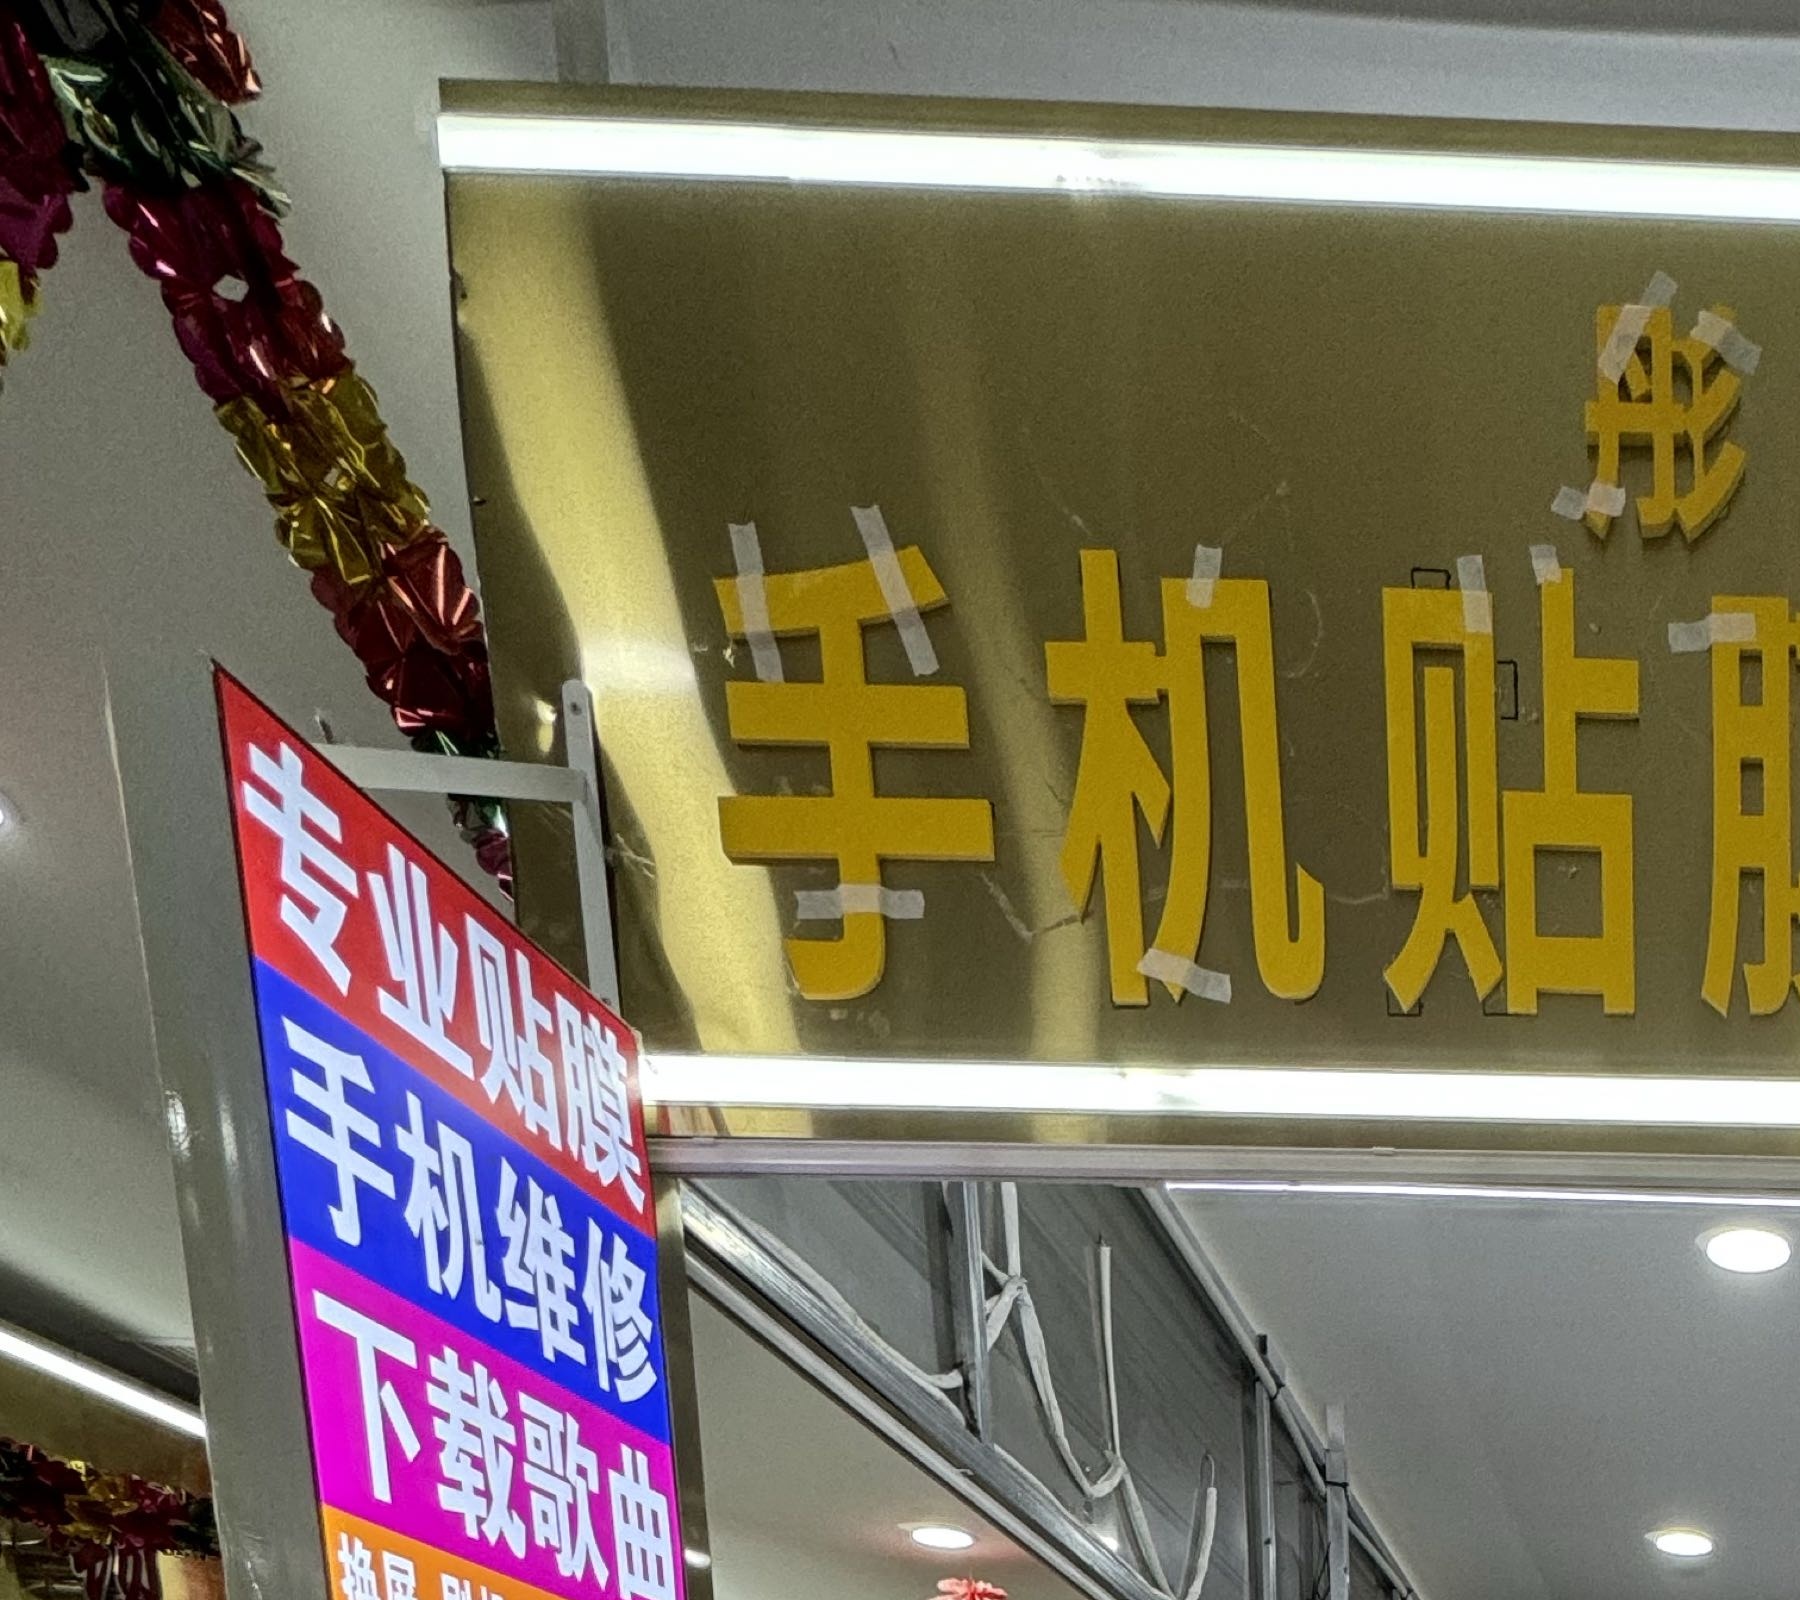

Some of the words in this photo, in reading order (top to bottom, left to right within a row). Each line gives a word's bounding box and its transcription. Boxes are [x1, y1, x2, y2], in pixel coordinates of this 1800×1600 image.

[241, 742, 646, 1214] 专业贴膜
[282, 1014, 658, 1404] 手机维修
